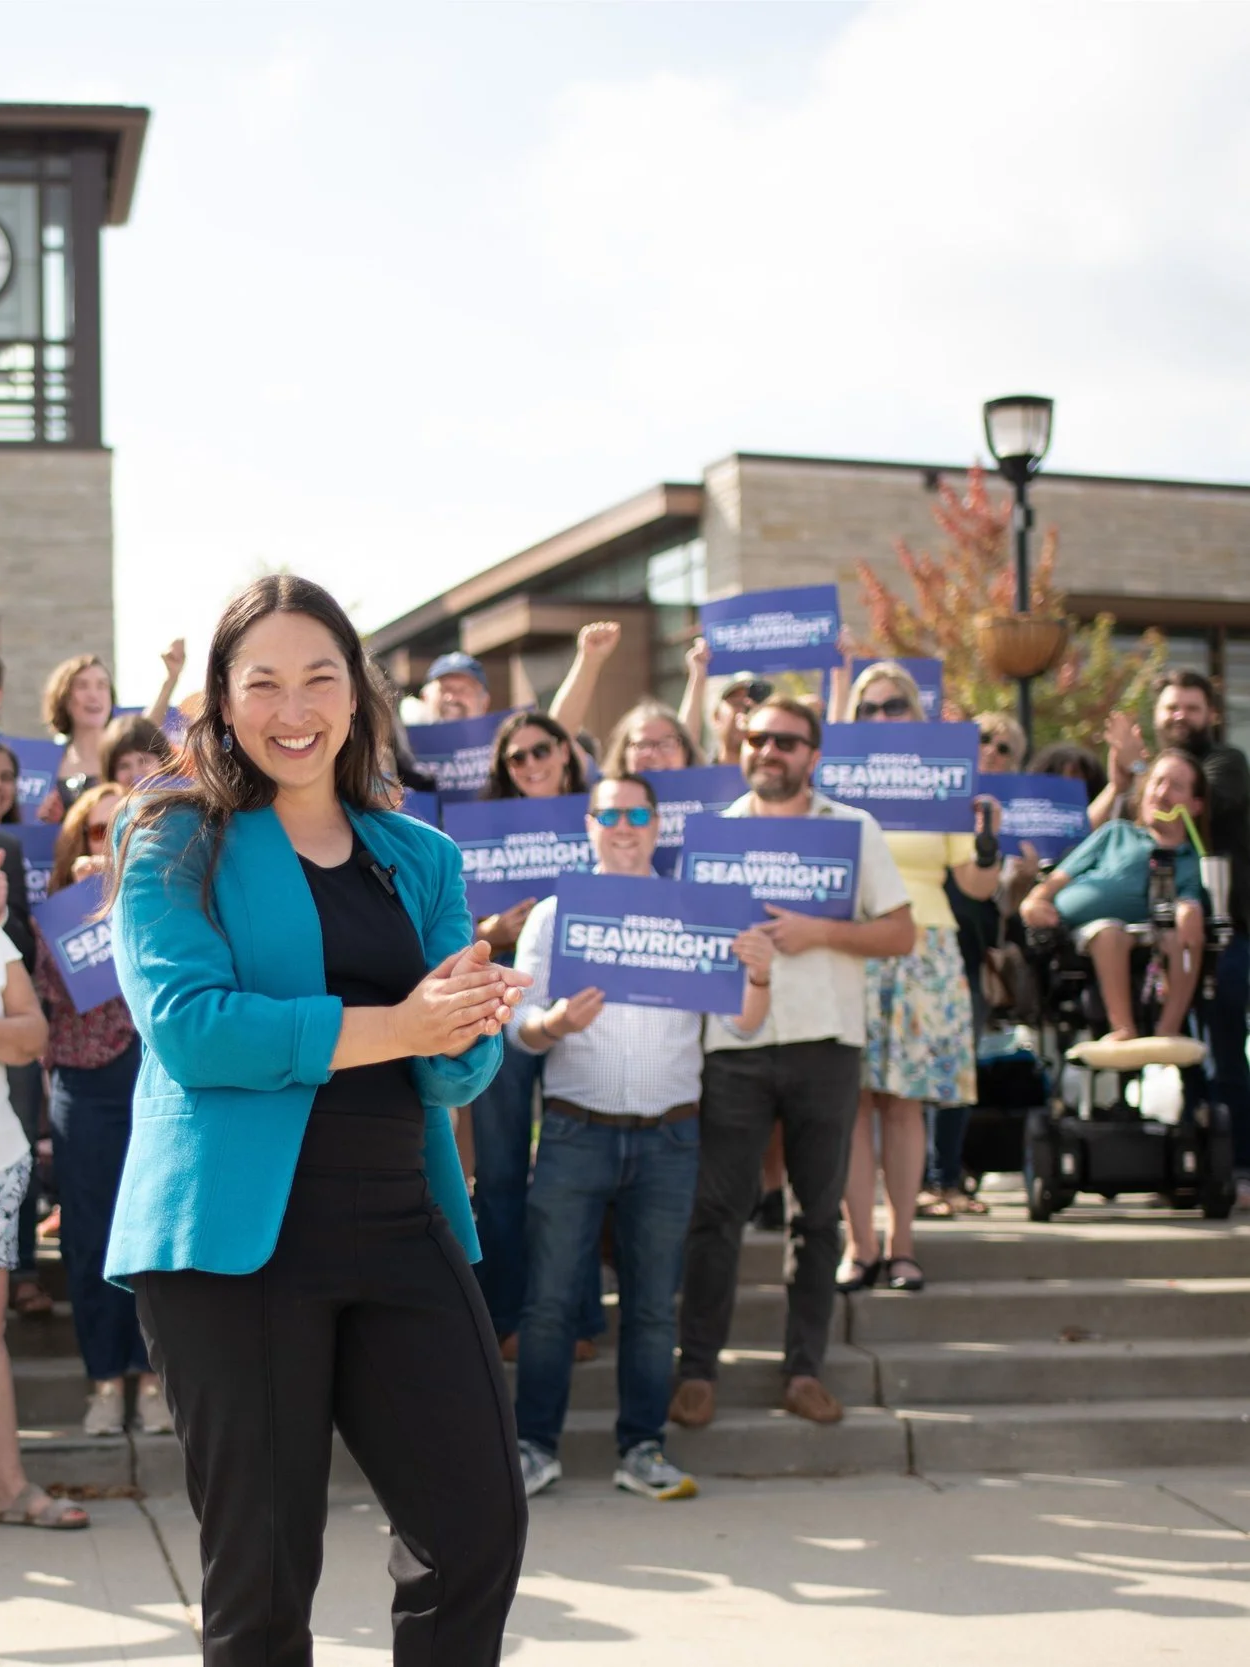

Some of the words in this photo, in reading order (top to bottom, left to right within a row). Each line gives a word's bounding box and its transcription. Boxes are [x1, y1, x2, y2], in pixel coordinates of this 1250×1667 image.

[713, 617, 832, 646] SEAWRIGHT
[821, 764, 968, 789] SEAWRIGHT
[744, 850, 800, 866] JESSICA
[475, 868, 505, 882] FOR
[694, 861, 848, 889] SEAWRIGHT
[751, 886, 815, 901] SSEMBLY
[622, 914, 684, 932] JESSICA
[568, 923, 735, 961] SEAWRIGHT
[584, 949, 617, 964] FOR
[618, 951, 699, 972] ASSEMBLY
